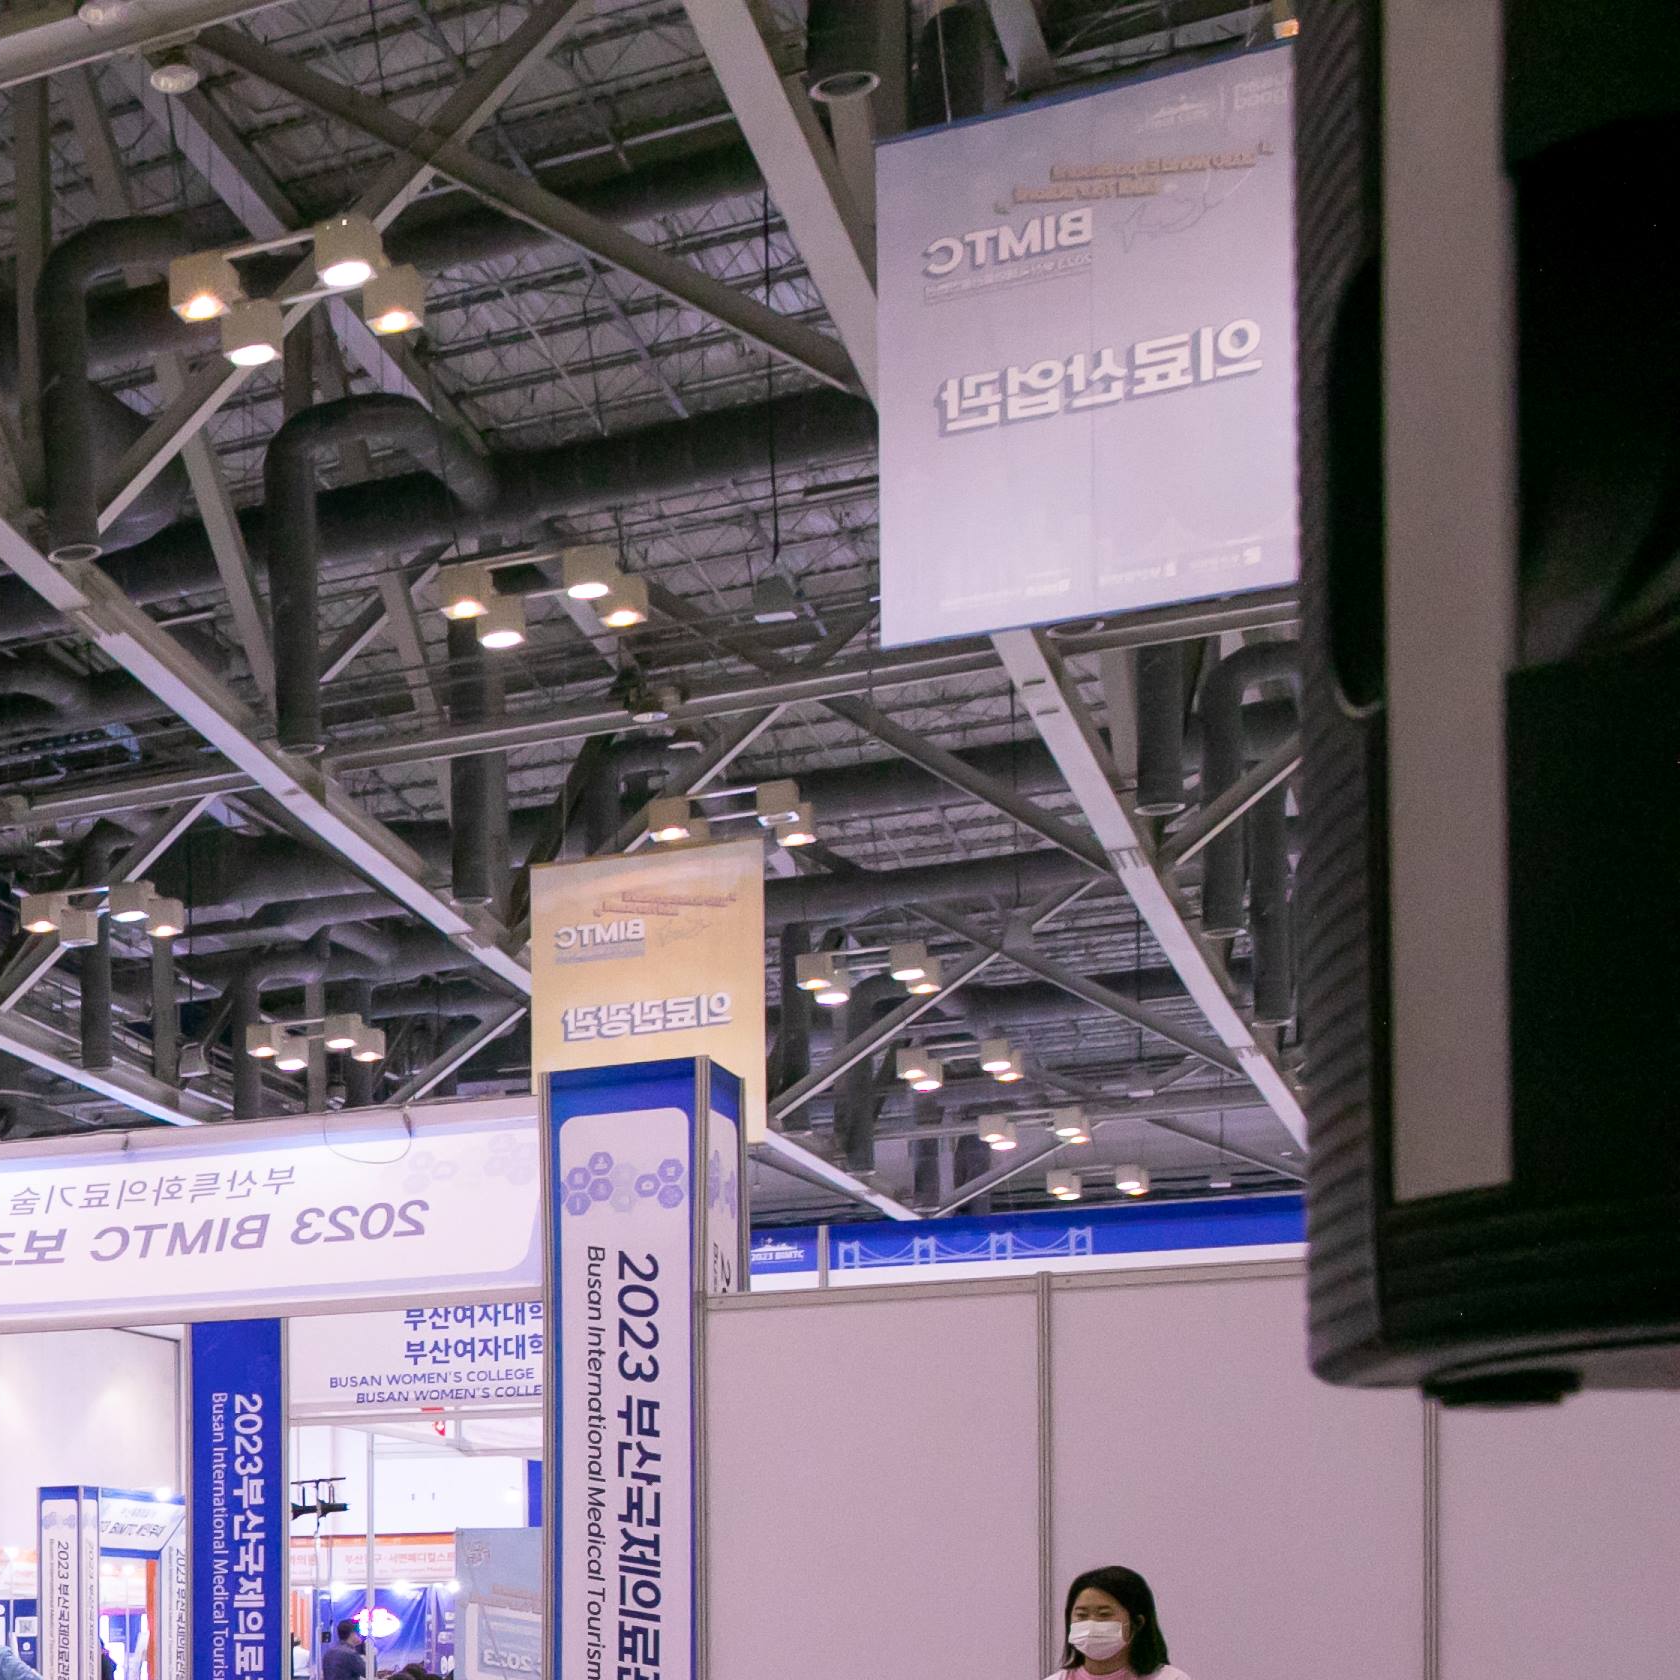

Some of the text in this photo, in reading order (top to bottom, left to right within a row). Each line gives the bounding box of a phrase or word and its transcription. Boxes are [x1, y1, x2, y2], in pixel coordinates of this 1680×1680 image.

[587, 1245, 606, 1319] Busan
[617, 1250, 660, 1383] 2023
[329, 1367, 535, 1388] BUSAN WOMEN'S COLLEGE
[356, 1384, 543, 1404] BUSAN WOMEN'S COLLE
[587, 1326, 606, 1482] International
[212, 1392, 228, 1442] Busan
[212, 1447, 229, 1555] International
[587, 1486, 606, 1582] Medical
[57, 1541, 70, 1580] 2023
[212, 1559, 229, 1624] Medical
[586, 1587, 606, 1680] Tourism
